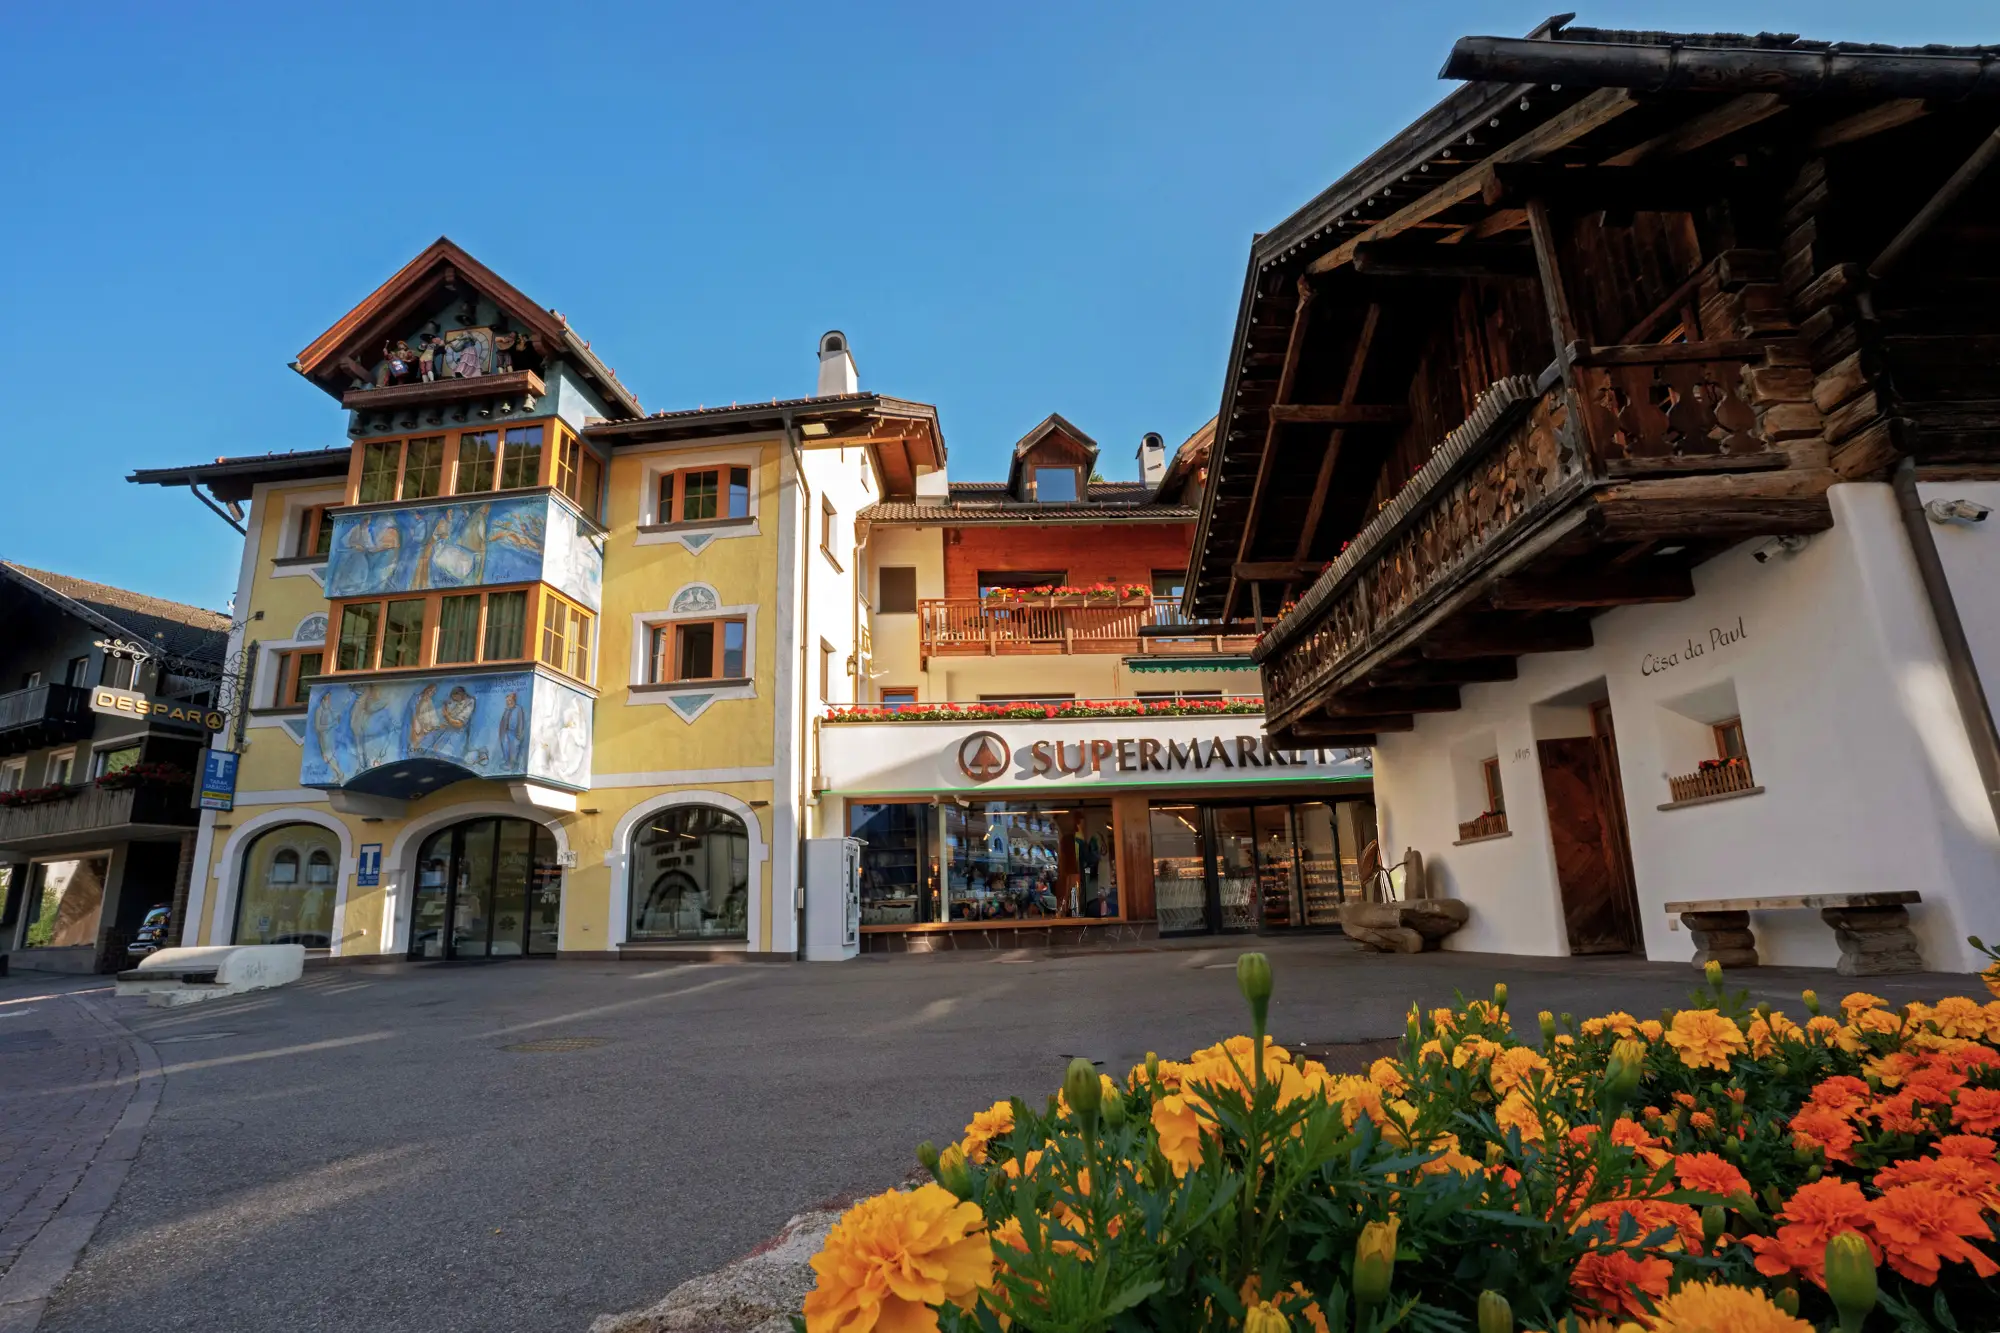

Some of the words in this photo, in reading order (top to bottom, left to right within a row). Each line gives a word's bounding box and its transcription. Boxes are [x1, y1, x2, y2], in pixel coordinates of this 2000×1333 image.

[1641, 653, 1679, 677] Cësa
[1684, 639, 1704, 660] da
[1709, 616, 1748, 652] Paul
[97, 692, 202, 724] DESPAR
[211, 751, 234, 778] T
[361, 846, 381, 875] T
